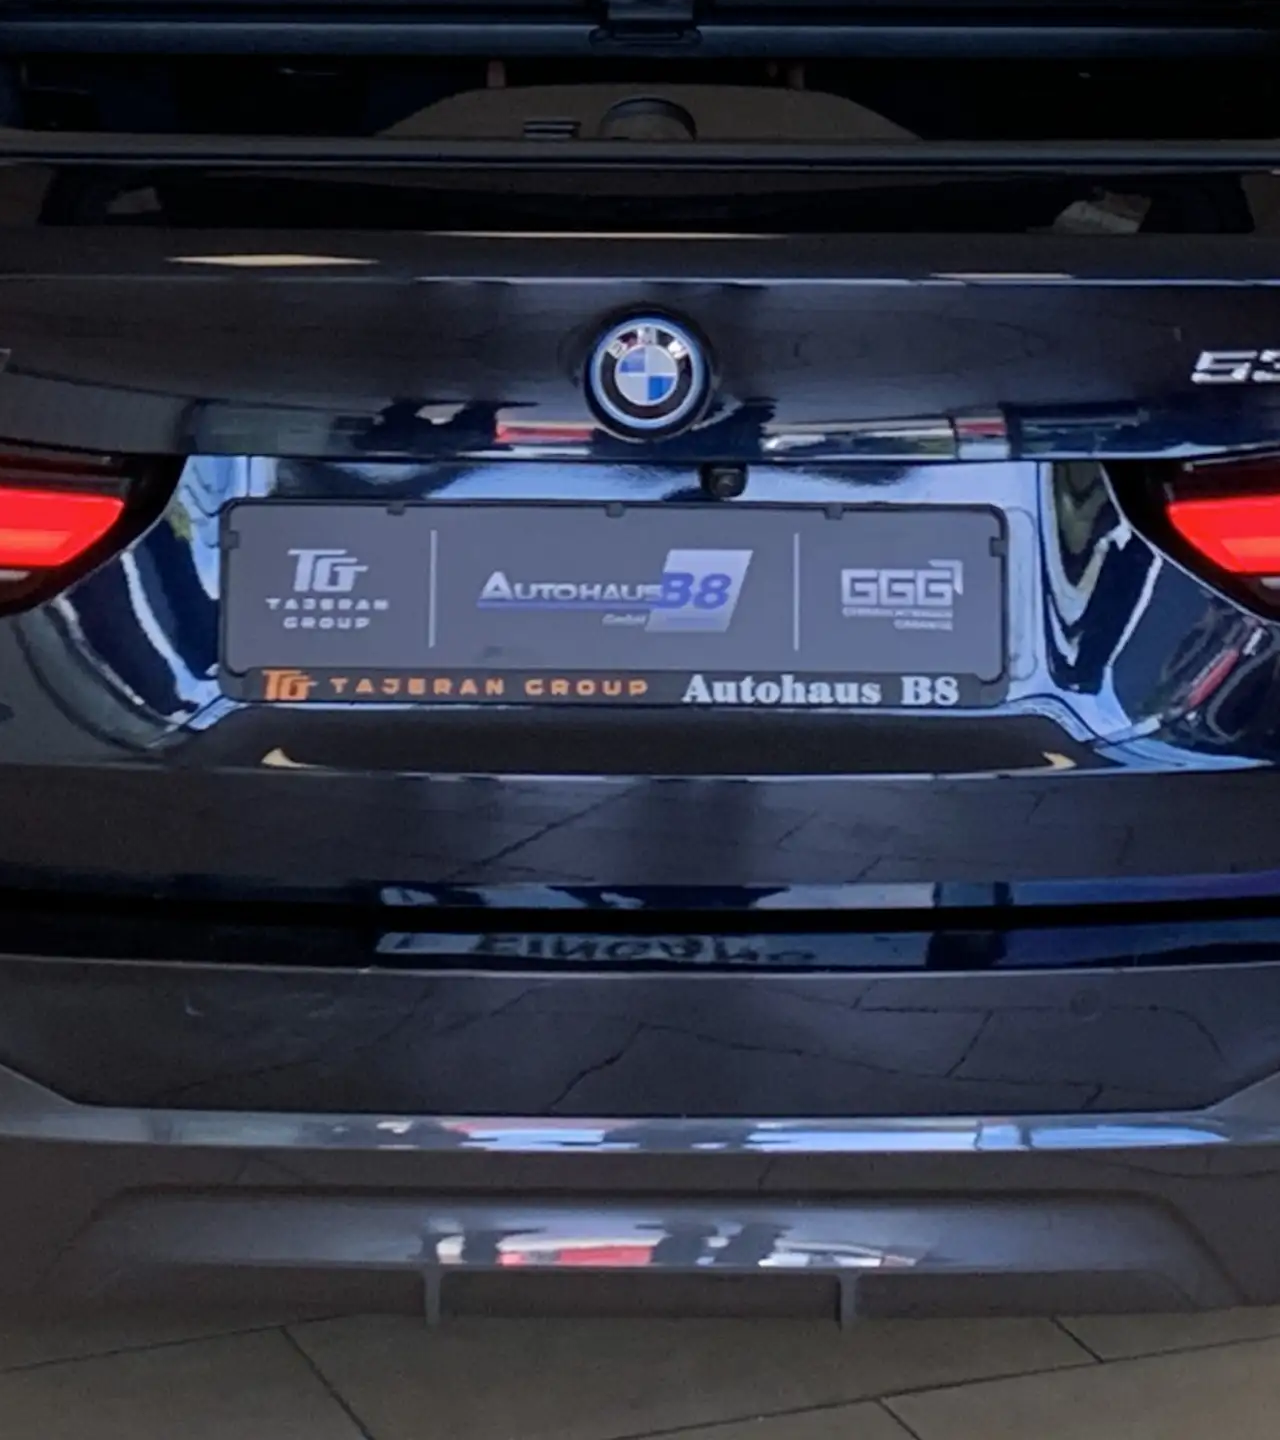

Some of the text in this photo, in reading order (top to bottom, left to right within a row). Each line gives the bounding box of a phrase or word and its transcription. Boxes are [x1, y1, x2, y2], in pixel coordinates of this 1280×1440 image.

[287, 548, 369, 592] TG
[265, 598, 390, 610] TAJERAN
[657, 571, 733, 610] B8
[841, 568, 954, 607] GGG
[283, 617, 370, 630] GROUP
[261, 669, 649, 701] TG TAJERAN GROUP
[681, 673, 960, 706] Autohaus B8
